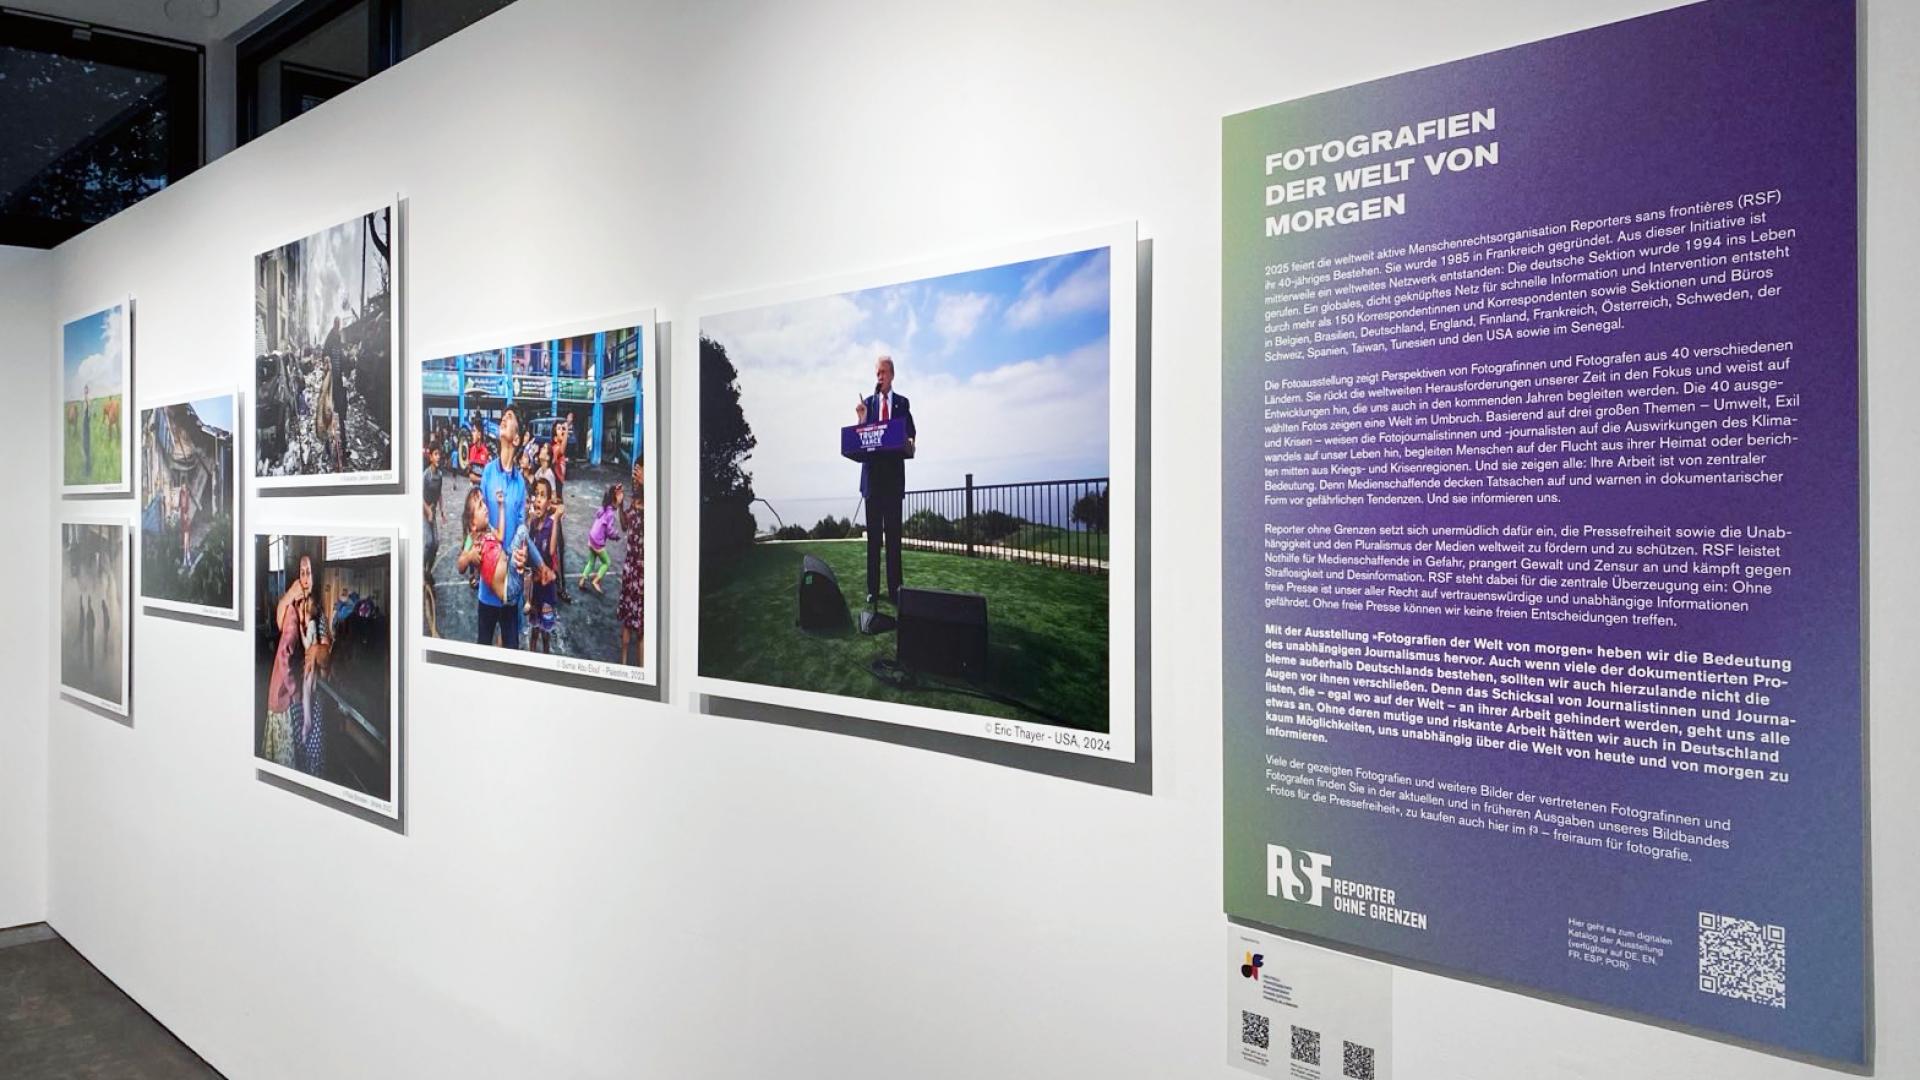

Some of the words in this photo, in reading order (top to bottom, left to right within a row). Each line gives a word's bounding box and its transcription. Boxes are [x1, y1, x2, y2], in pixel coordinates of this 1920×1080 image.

[1266, 108, 1495, 175] FOTOGRAFIEN
[1266, 176, 1326, 206] DER
[1334, 158, 1415, 192] WELT
[1424, 142, 1498, 175] VON
[1265, 262, 1288, 274] 2025
[1292, 259, 1314, 271] feiert
[1317, 256, 1331, 267] die
[1334, 250, 1373, 265] weltweit
[1377, 245, 1405, 259] aktive
[1409, 222, 1566, 257] Menschenrechtsorganisation
[1571, 212, 1630, 234] Reporters
[1636, 210, 1665, 222] sans
[1670, 198, 1732, 218] frontières
[1738, 191, 1780, 210] (RSF)
[1266, 194, 1405, 236] MORGEN
[1264, 320, 1289, 332] durch
[1292, 317, 1315, 329] mehr
[1318, 316, 1331, 326] als
[1335, 313, 1354, 324] 150
[1357, 301, 1459, 324] Korrespondentinnen
[1463, 298, 1483, 311] und
[1488, 287, 1586, 310] Korrespondenten
[1591, 282, 1626, 297] sowie
[1631, 275, 1695, 293] Sektionen
[1700, 271, 1725, 285] und
[1731, 266, 1772, 282] Büros
[1265, 337, 1272, 346] in
[1275, 333, 1310, 348] Belgien,
[1314, 328, 1356, 343] Brasilien,
[1361, 321, 1425, 338] Deutschland,
[1430, 316, 1475, 332] England,
[1479, 310, 1528, 326] Finnland,
[1533, 303, 1596, 321] Frankreich,
[1602, 293, 1671, 314] Österreich,
[1676, 287, 1752, 307] Schweden,
[1758, 284, 1780, 298] der
[1265, 379, 1278, 389] Die
[1282, 373, 1352, 390] Fotoausstellung
[1356, 371, 1378, 384] zeigt
[1382, 366, 1445, 382] Perspektiven
[1449, 366, 1467, 375] von
[1471, 358, 1545, 376] Fotografinnen
[1550, 356, 1571, 368] und
[1576, 350, 1640, 368] Fotografen
[1645, 350, 1666, 361] aus
[1672, 346, 1688, 359] 40
[1694, 338, 1792, 357] verschiedenen
[1264, 480, 1316, 492] Bedeutung.
[1319, 479, 1344, 489] Denn
[1347, 477, 1440, 488] Medienschaffende
[1443, 476, 1483, 487] decken
[1486, 475, 1543, 486] Tatsachen
[1547, 474, 1565, 485] auf
[1569, 474, 1592, 485] und
[1595, 475, 1641, 484] warnen
[1645, 473, 1656, 484] in
[1660, 470, 1783, 484] dokumentarischer
[1264, 524, 1305, 535] Reporter
[1307, 524, 1331, 533] ohne
[1333, 524, 1376, 534] Grenzen
[1379, 525, 1404, 534] setzt
[1407, 524, 1428, 534] sich
[1431, 524, 1498, 535] unermüdlich
[1502, 525, 1532, 535] dafür
[1536, 525, 1556, 537] ein,
[1560, 525, 1579, 536] die
[1583, 525, 1670, 537] Pressefreiheit
[1675, 526, 1715, 537] sowie
[1720, 526, 1741, 537] die
[1746, 526, 1792, 538] Unab-
[1265, 596, 1309, 609] gefährdet.
[1313, 598, 1338, 608] Ohne
[1342, 599, 1362, 610] freie
[1366, 600, 1400, 612] Presse
[1404, 602, 1441, 614] können
[1445, 604, 1460, 615] wir
[1464, 605, 1492, 617] keine
[1496, 607, 1527, 618] freien
[1531, 608, 1627, 626] Entscheidungen
[1632, 613, 1676, 626] treffen.
[1265, 624, 1281, 634] Mit
[1284, 625, 1301, 636] der
[1305, 627, 1368, 642] Ausstellung
[1450, 636, 1469, 647] der
[1474, 637, 1502, 649] Welt
[1506, 642, 1529, 651] von
[1597, 645, 1641, 659] heben
[1646, 648, 1669, 661] wir
[1674, 650, 1697, 663] die
[1703, 652, 1790, 672] Bedeutung
[1265, 653, 1296, 665] bleme
[1299, 656, 1352, 669] außerhalb
[1356, 660, 1433, 676] Deutschlands
[1437, 667, 1496, 683] bestehen,
[1500, 672, 1544, 686] sollten
[1548, 676, 1569, 688] wir
[1573, 678, 1605, 691] auch
[1610, 681, 1696, 699] hierzulande
[1702, 688, 1740, 703] nicht
[1744, 692, 1769, 705] die
[995, 723, 1012, 736] Eric
[1015, 726, 1045, 743] Thayer
[1055, 732, 1080, 748] USA,
[1083, 737, 1111, 751] 2024
[1266, 726, 1327, 742] informieren.
[1266, 754, 1286, 766] Viele
[1290, 758, 1304, 769] der
[1307, 760, 1352, 778] gezeigten
[1356, 767, 1411, 787] Fotografien
[1415, 775, 1434, 788] und
[1438, 778, 1476, 794] weitere
[1481, 784, 1512, 799] Bilder
[1517, 790, 1534, 802] der
[1540, 794, 1606, 813] vertretenen
[1611, 803, 1699, 829] Fotografinnen
[1705, 816, 1729, 831] und
[1267, 843, 1332, 907] RSF
[1334, 879, 1396, 905] REPORTER
[1334, 895, 1366, 916] OHNE
[1370, 904, 1427, 930] GRENZEN
[1568, 917, 1584, 927] Hier
[1587, 922, 1604, 932] geht
[1619, 929, 1635, 938] zum
[1637, 931, 1672, 945] digitalen
[1568, 929, 1598, 943] Katalog
[1600, 936, 1614, 944] der
[1616, 939, 1664, 956] Ausstellung
[1568, 939, 1608, 954] (verfügbar
